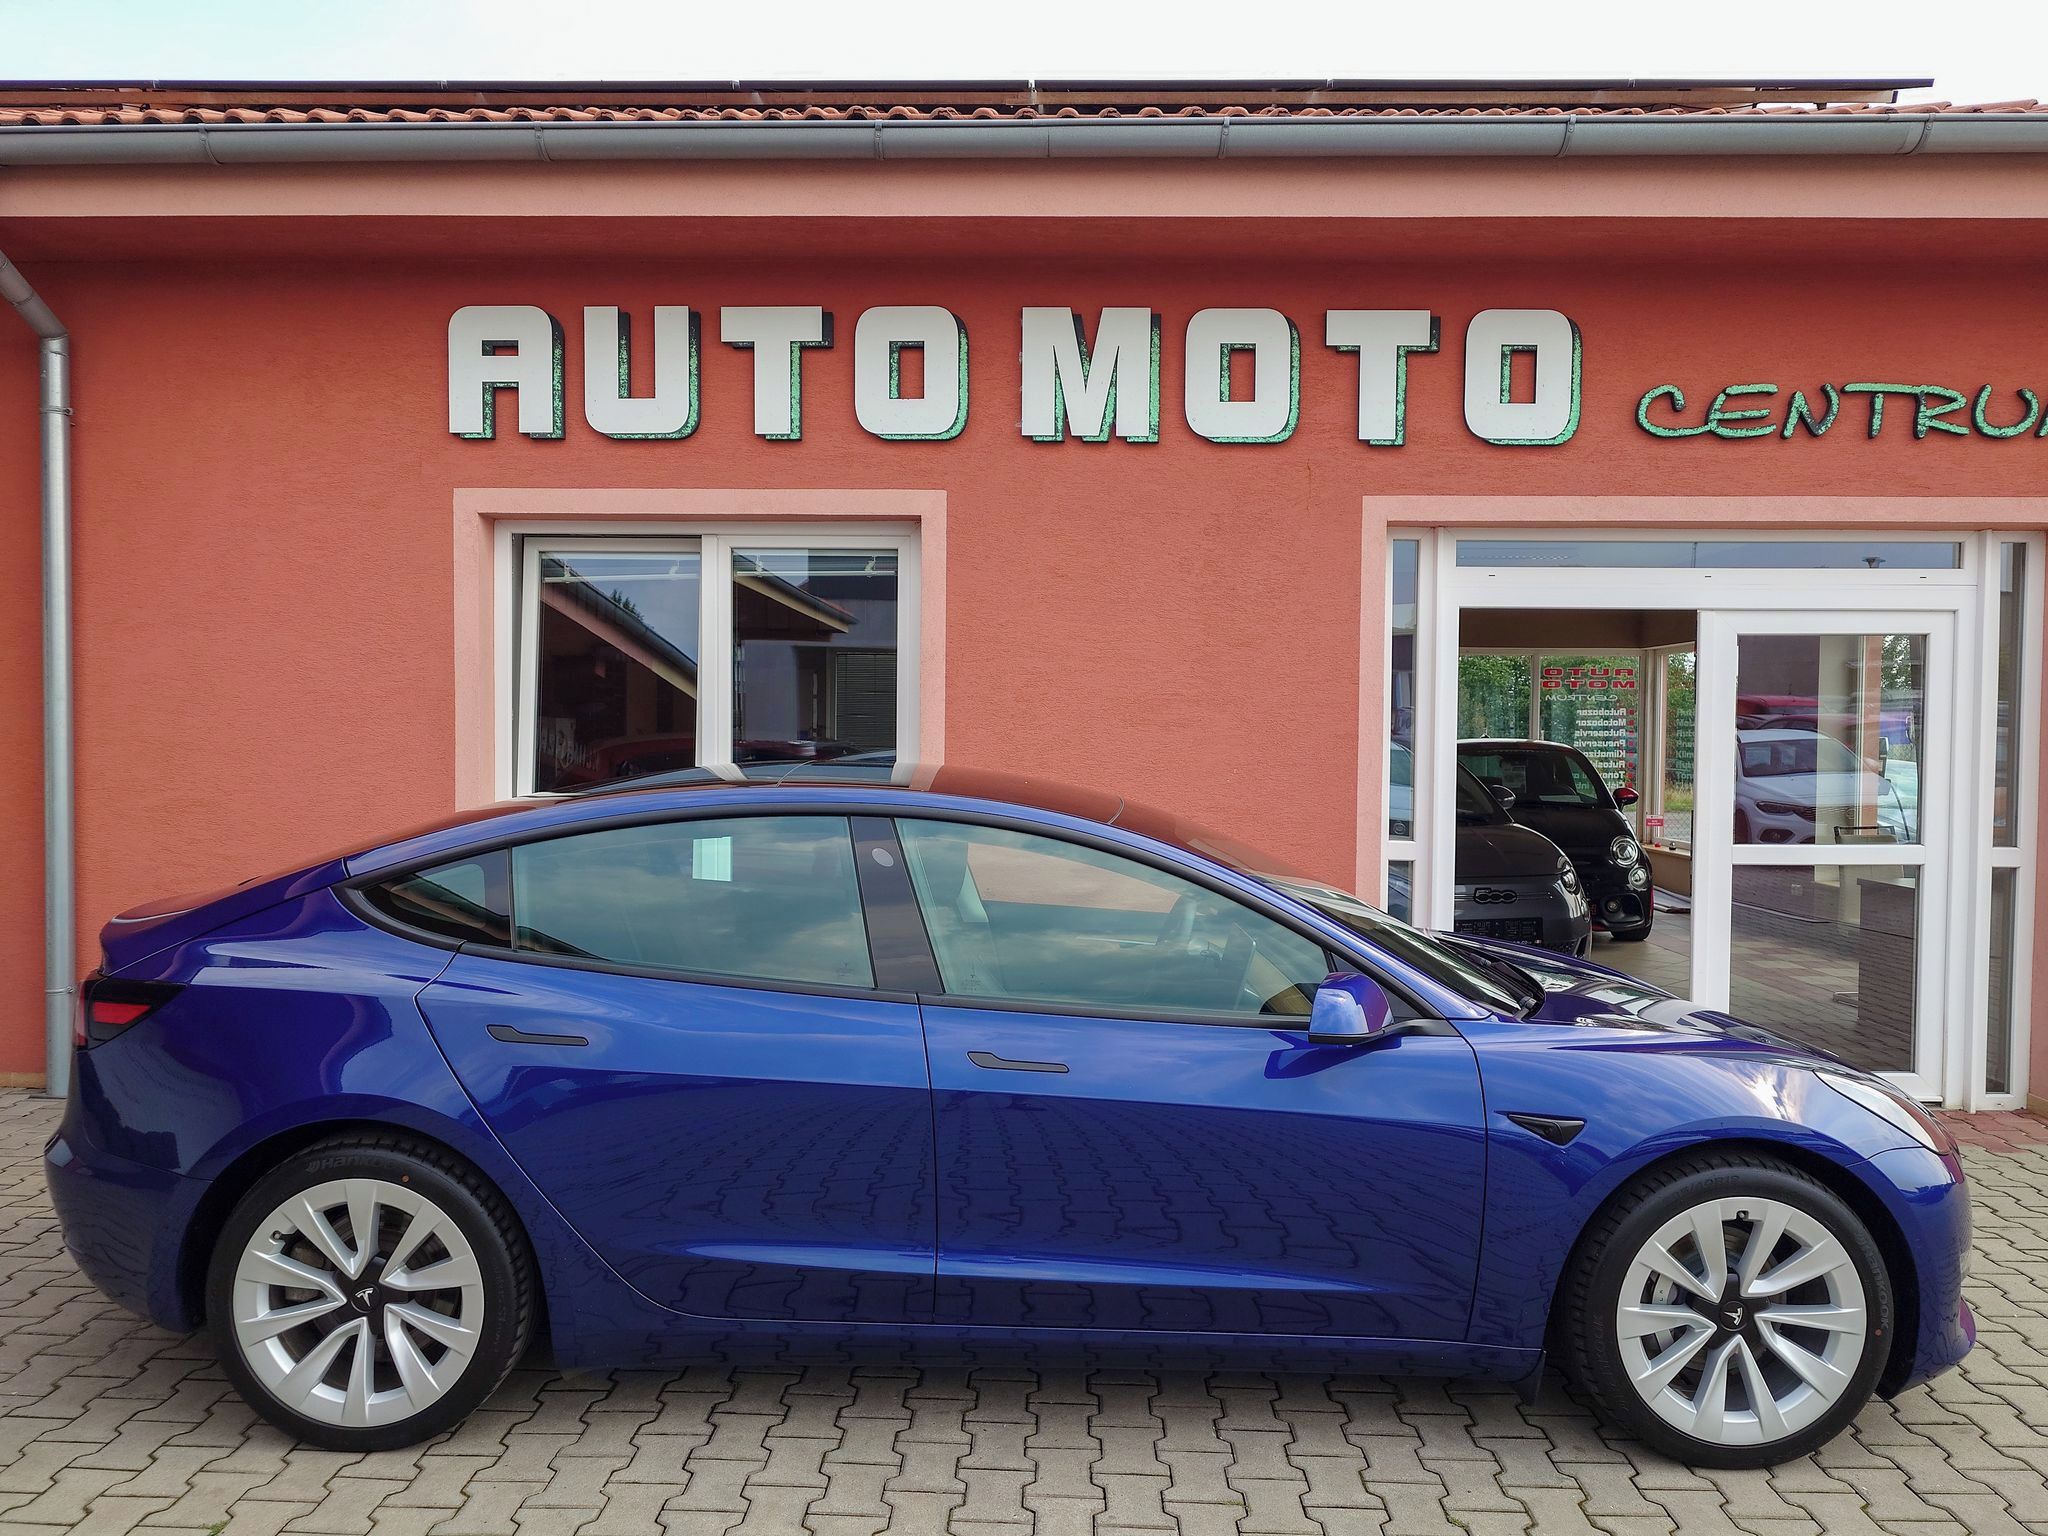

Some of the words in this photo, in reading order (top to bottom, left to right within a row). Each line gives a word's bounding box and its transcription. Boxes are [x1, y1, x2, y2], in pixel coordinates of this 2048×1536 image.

[448, 305, 968, 440] AUTO
[1021, 307, 1582, 446] MOTO
[1635, 383, 2048, 439] CENTRU
[1474, 887, 1518, 904] 500
